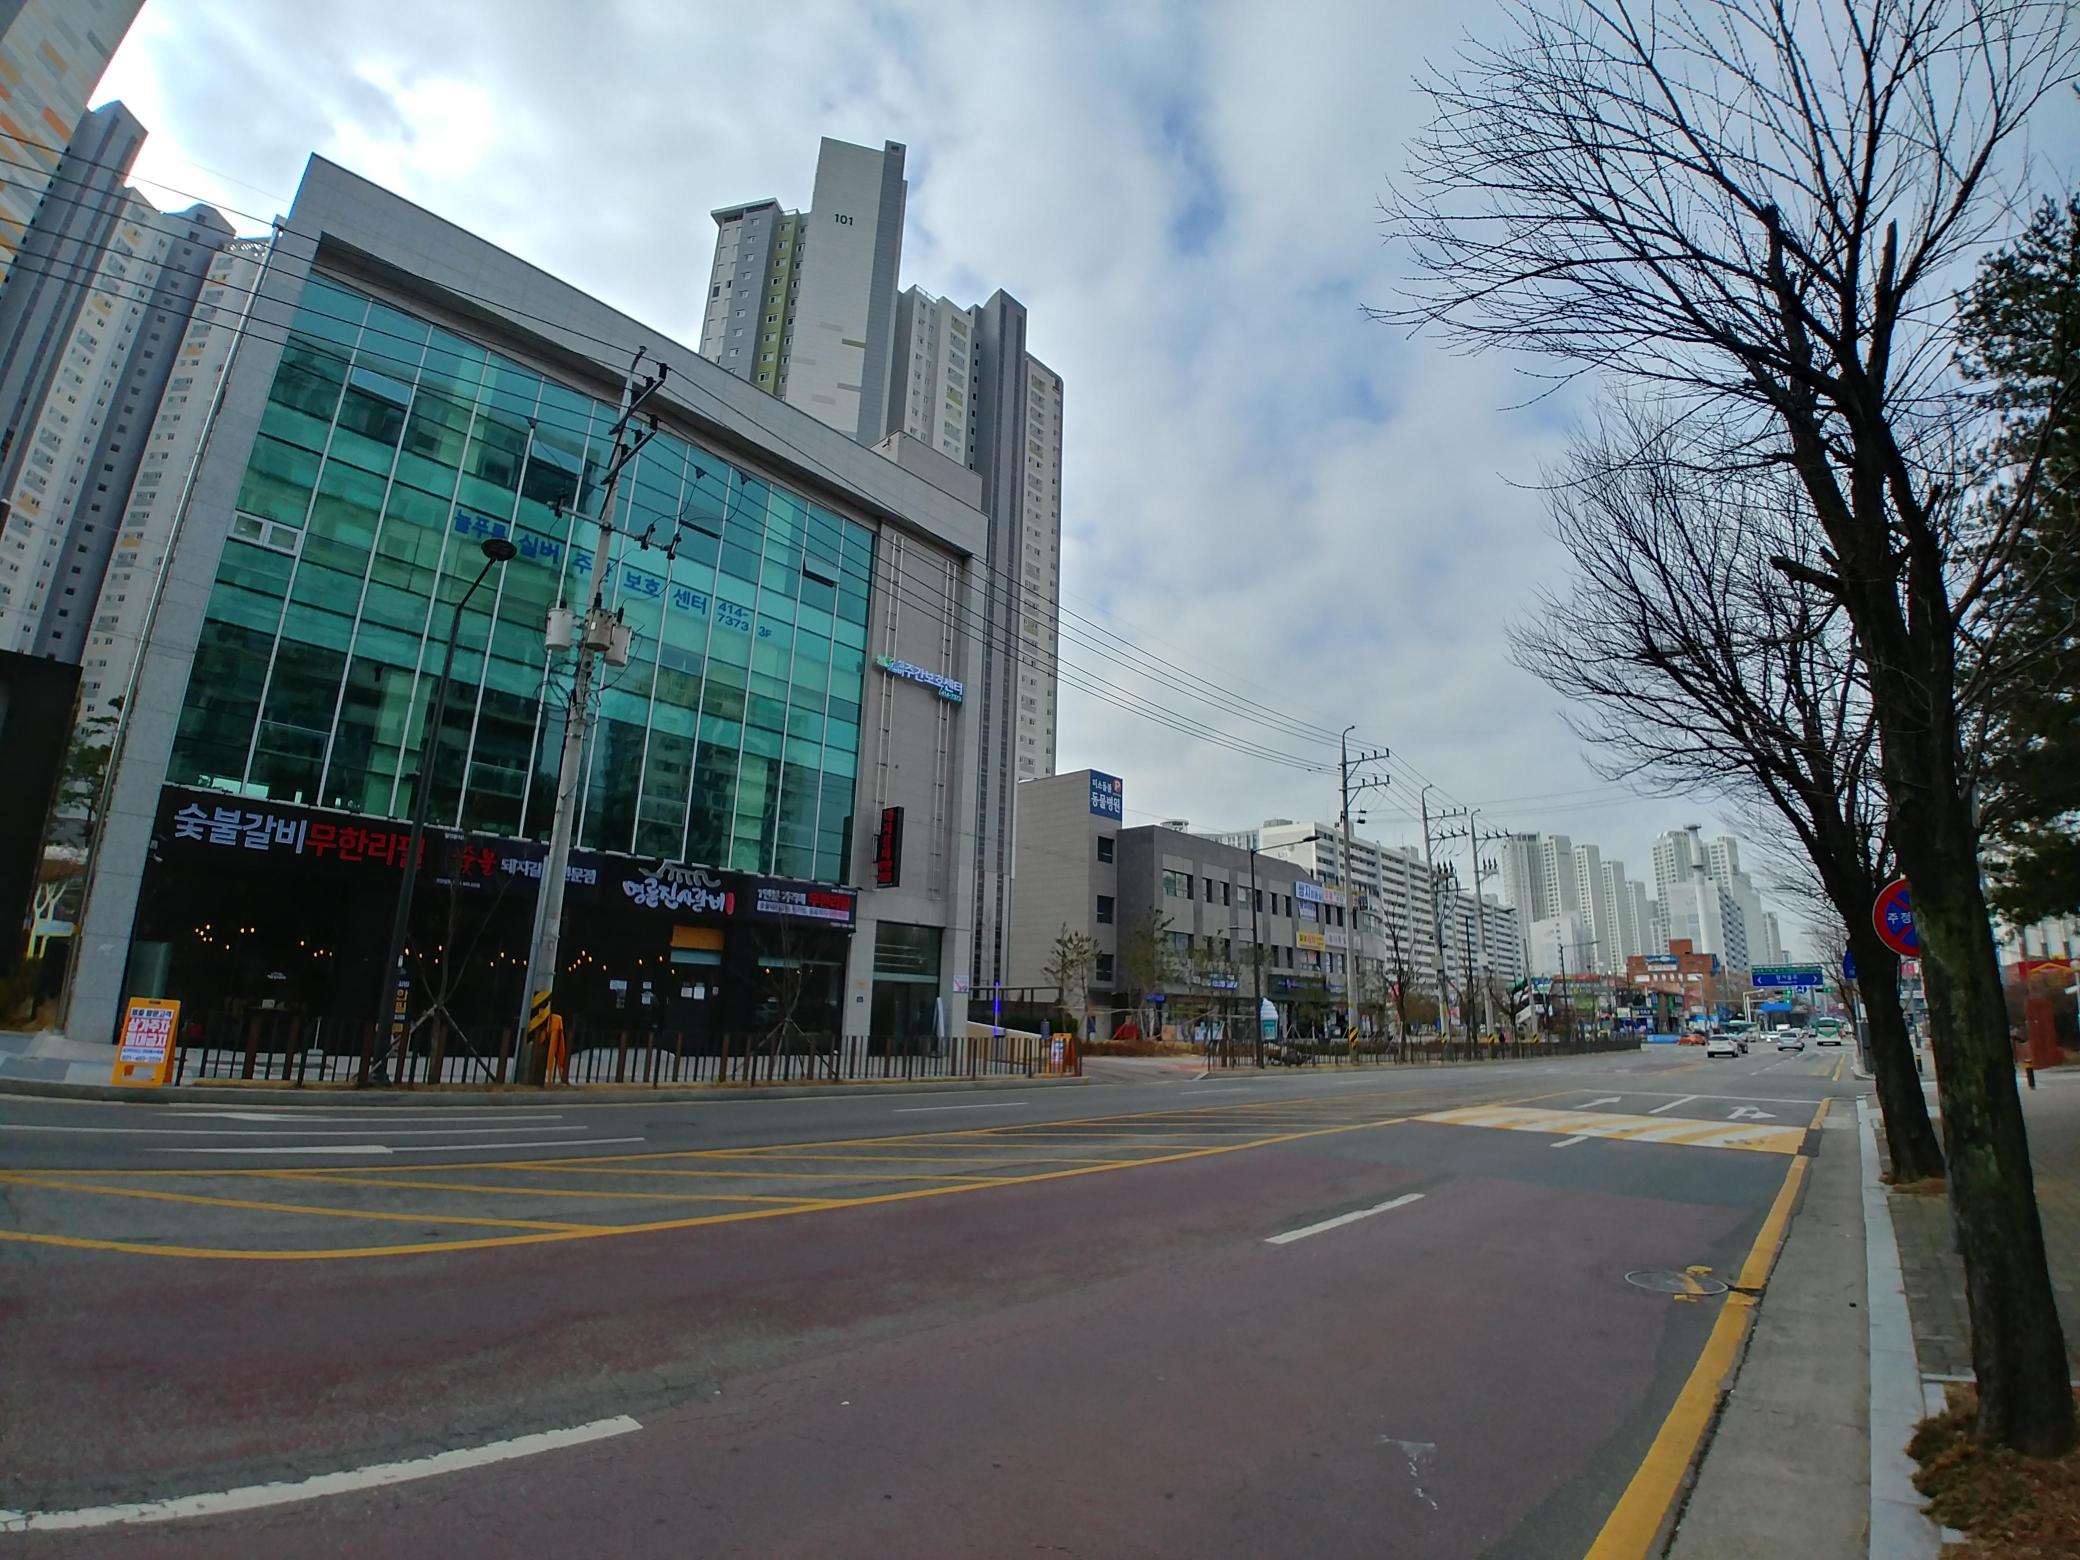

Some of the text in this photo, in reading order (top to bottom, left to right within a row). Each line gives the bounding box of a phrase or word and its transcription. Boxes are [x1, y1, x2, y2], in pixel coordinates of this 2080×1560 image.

[835, 213, 853, 226] 101
[519, 535, 560, 565] 실버
[623, 571, 661, 598] 보호
[673, 587, 708, 616] 센터
[717, 613, 772, 638] 7373 3F
[174, 803, 426, 870] 숯불갈비 무한리필
[623, 877, 725, 912] 명륜진사갈비
